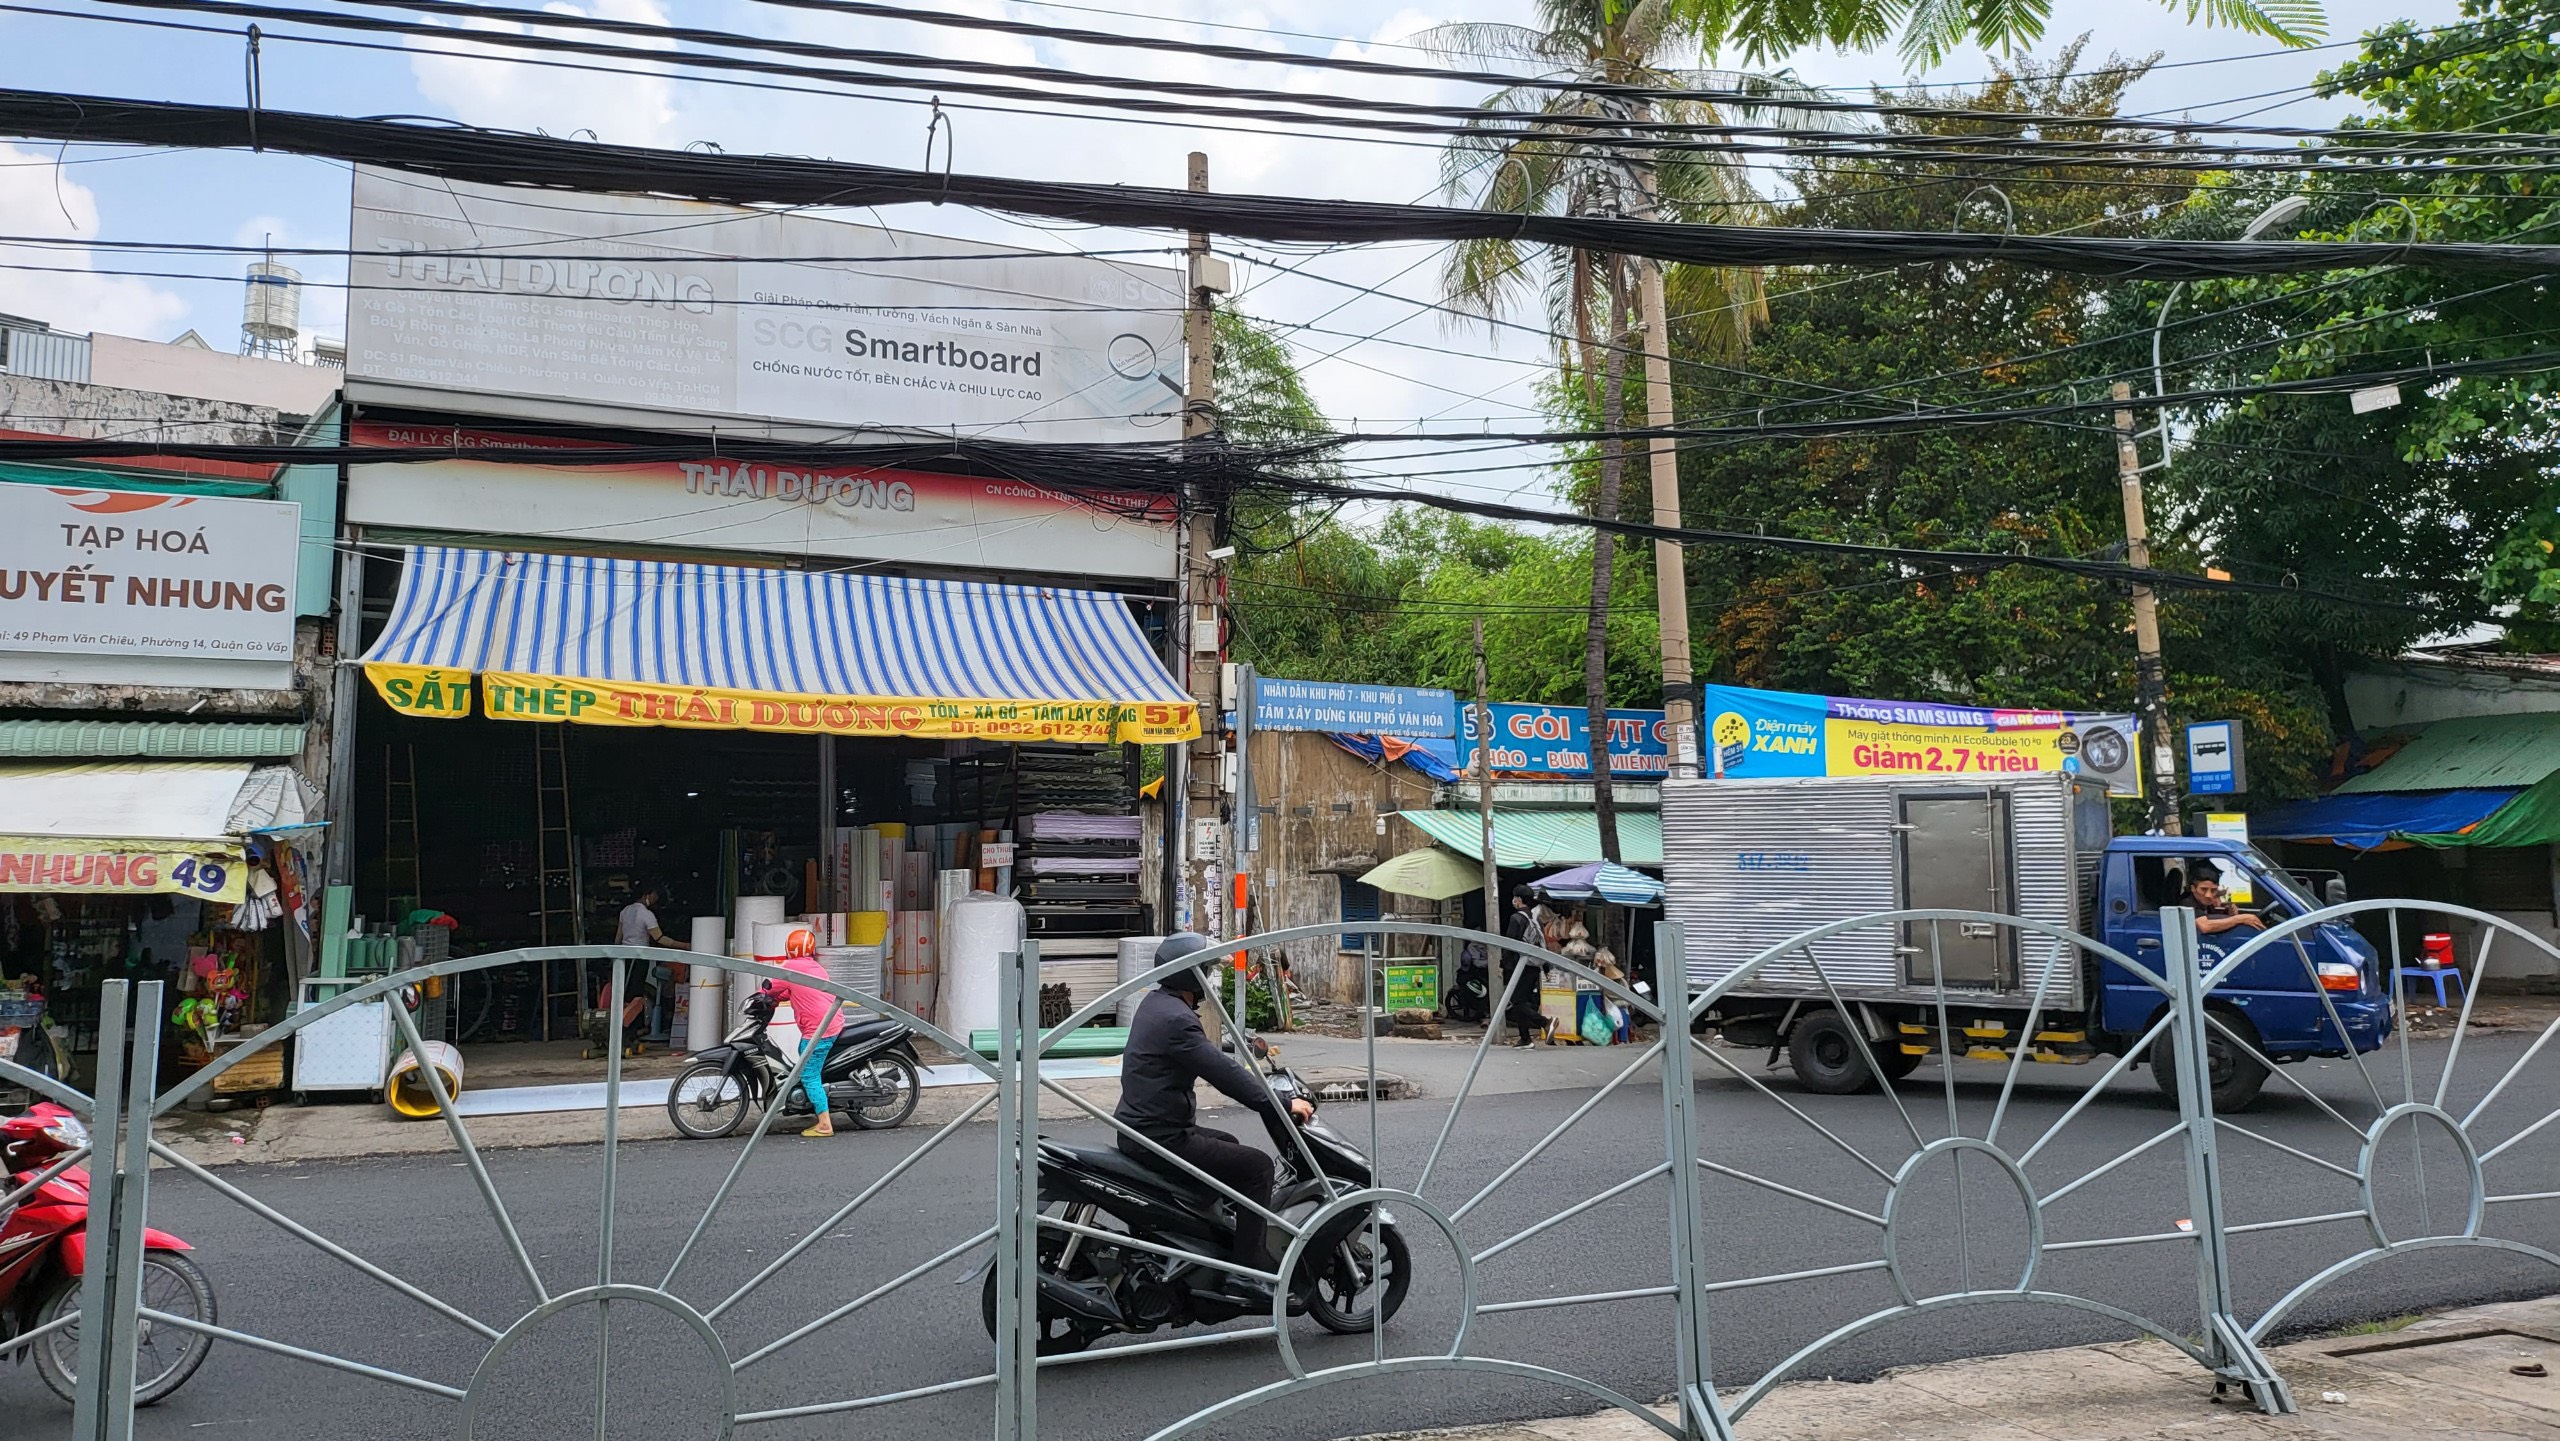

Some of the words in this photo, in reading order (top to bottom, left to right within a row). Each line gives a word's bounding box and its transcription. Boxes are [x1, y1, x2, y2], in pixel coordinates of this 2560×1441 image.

[422, 217, 451, 231] SCG
[376, 237, 504, 290] THÁI
[518, 255, 714, 315] DƯƠNG
[521, 303, 551, 315] SCG
[753, 290, 779, 304] Giải
[782, 294, 813, 311] Pháp
[876, 306, 918, 324] Tường,
[920, 311, 949, 325] Vách
[952, 315, 982, 331] Ngăn
[985, 321, 994, 331] &
[996, 320, 1018, 333] Sàn
[1020, 323, 1043, 337] Nhà
[543, 319, 576, 333] Theo
[543, 334, 586, 350] Phong
[753, 317, 833, 354] SCG
[845, 328, 1042, 378] Smartboard
[390, 351, 404, 362] 51
[676, 380, 721, 396] Tp.HCM
[395, 366, 480, 385] 0932.612.344
[752, 359, 801, 376] CHỐNG
[803, 363, 843, 380] NƯỚC
[845, 366, 873, 384] TỐT,
[875, 370, 901, 386] BỀN
[903, 374, 938, 391] CHẮC
[940, 377, 956, 392] VÀ
[958, 381, 988, 397] CHỊU
[990, 384, 1016, 400] LỰC
[1018, 387, 1043, 402] CAO
[679, 461, 766, 500] THÁI
[777, 471, 915, 512] DƯƠNG
[986, 483, 1002, 496] CN
[1004, 484, 1036, 499] CÔNG
[61, 522, 125, 556] TẠP
[136, 525, 210, 555] HOÁ
[127, 576, 286, 613] NHUNG
[13, 630, 30, 642] 49
[32, 631, 69, 646] Phạm
[72, 632, 96, 645] Văn
[99, 633, 138, 648] Chiêu,
[141, 635, 190, 650] Phường
[193, 638, 208, 650] 14,
[210, 639, 244, 655] Quận
[246, 640, 263, 652] Gò
[266, 640, 289, 654] Vấp
[385, 670, 471, 712] SẮT
[487, 682, 598, 718] THÉP
[609, 688, 741, 726] THÁI
[750, 697, 925, 732] DƯƠNG
[1263, 682, 1288, 699] NHÂN
[1290, 683, 1308, 700] DÂN
[1310, 687, 1327, 701] KHU
[1329, 685, 1346, 702] PHỐ
[1347, 690, 1354, 702] 7
[1360, 690, 1377, 704] KHU
[1379, 687, 1396, 705] PHỐ
[1397, 692, 1403, 705] 8
[928, 698, 961, 718] TÔN
[974, 702, 994, 720] XÀ
[999, 701, 1018, 720] GỒ
[1032, 701, 1063, 721] TẤM
[1068, 700, 1094, 722] LẤY
[1096, 703, 1138, 723] SÁNG
[1144, 704, 1191, 725] 51
[1258, 702, 1284, 720] TÂM
[1287, 703, 1312, 721] XÂY
[1315, 706, 1346, 726] DỰNG
[1348, 710, 1371, 725] KHU
[1374, 706, 1397, 726] PHỐ
[1399, 711, 1420, 727] VĂN
[1422, 711, 1444, 728] HÓA
[1835, 703, 1893, 725] Tháng
[1894, 707, 1985, 727] SAMSUNG
[950, 719, 980, 734] ĐT:
[986, 721, 1035, 735] 0932
[1041, 722, 1076, 736] 612
[1604, 719, 1647, 749] VỊT
[1755, 718, 1786, 735] Điện
[1787, 720, 1818, 737] máy
[1848, 728, 1870, 741] Máy
[1871, 730, 1890, 743] giặt
[1892, 731, 1923, 745] thông
[1924, 733, 1950, 745] minh
[1952, 735, 1962, 745] AI
[1963, 735, 2018, 747] EcoBubble
[2020, 737, 2031, 747] 10
[2032, 737, 2042, 746] kg
[1752, 733, 1818, 755] XANH
[1547, 746, 1588, 770] BÚN
[1853, 742, 1923, 771] Giảm
[1926, 747, 1970, 772] 2.7
[0, 853, 159, 888] NHUNG
[171, 858, 227, 893] 49
